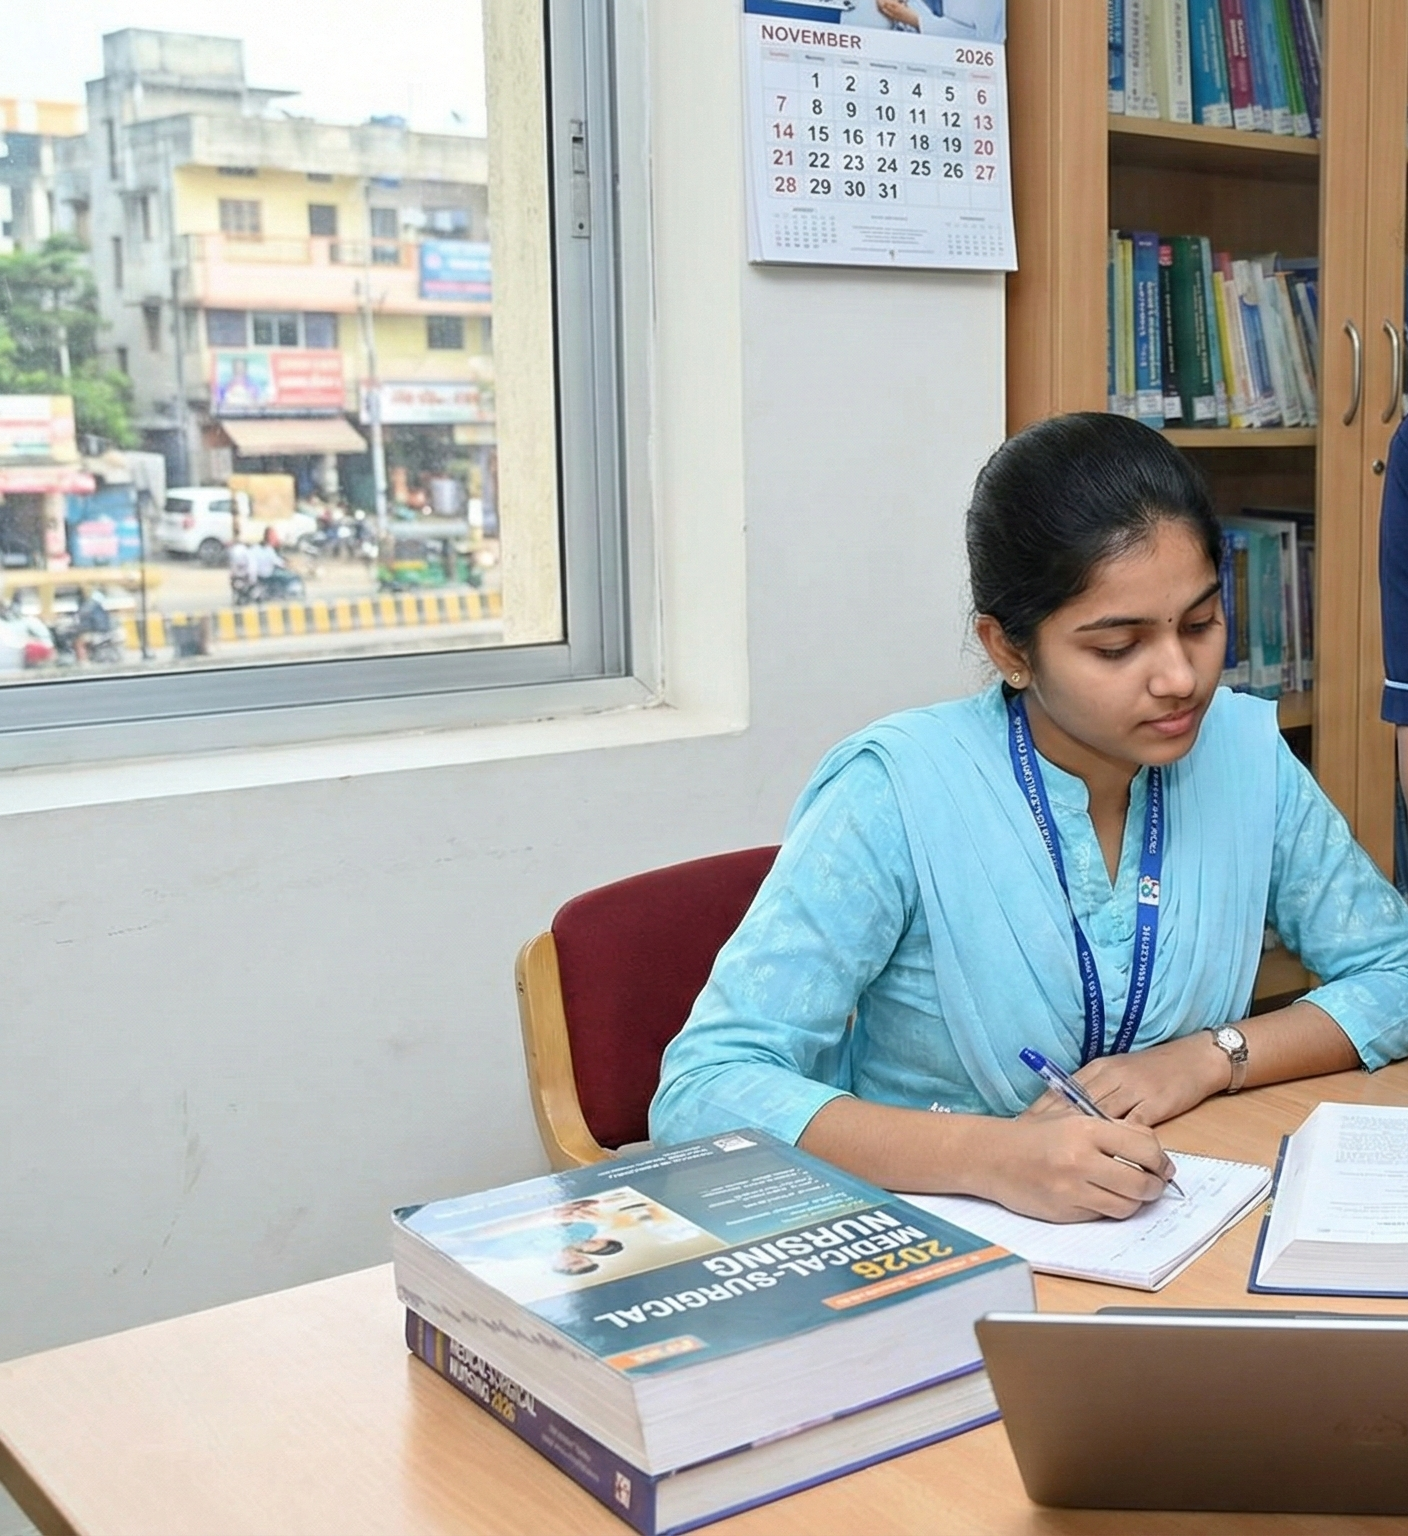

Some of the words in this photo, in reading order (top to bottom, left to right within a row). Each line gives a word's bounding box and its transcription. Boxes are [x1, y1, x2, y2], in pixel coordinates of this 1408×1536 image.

[761, 24, 862, 50] NOVEMBER
[955, 48, 994, 67] 2026
[811, 72, 819, 89] 1
[845, 75, 856, 92] 2
[879, 78, 890, 96] 3
[911, 82, 923, 99] 4
[945, 85, 955, 102] 5
[976, 89, 987, 105] 6
[776, 95, 787, 112] 7
[812, 98, 823, 116] 8
[845, 101, 857, 118] 9
[875, 105, 896, 122] 10
[909, 108, 926, 125] 11
[941, 111, 961, 128] 12
[973, 114, 994, 131] 13
[772, 122, 794, 139] 14
[808, 125, 830, 143] 15
[842, 128, 864, 145] 16
[876, 131, 897, 148] 17
[910, 134, 930, 151] 18
[942, 136, 962, 154] 19
[973, 139, 994, 156] 20
[772, 148, 793, 166] 21
[808, 151, 830, 169] 22
[843, 154, 865, 172] 23
[877, 156, 898, 173] 24
[910, 159, 932, 177] 25
[942, 162, 964, 179] 26
[975, 164, 995, 181] 27
[774, 176, 797, 193] 28
[809, 178, 832, 195] 29
[844, 180, 866, 198] 30
[878, 182, 897, 199] 31
[702, 1210, 902, 1278] NURSING
[851, 1240, 953, 1280] 2026
[594, 1215, 928, 1328] MEDICAL-SURGICAL
